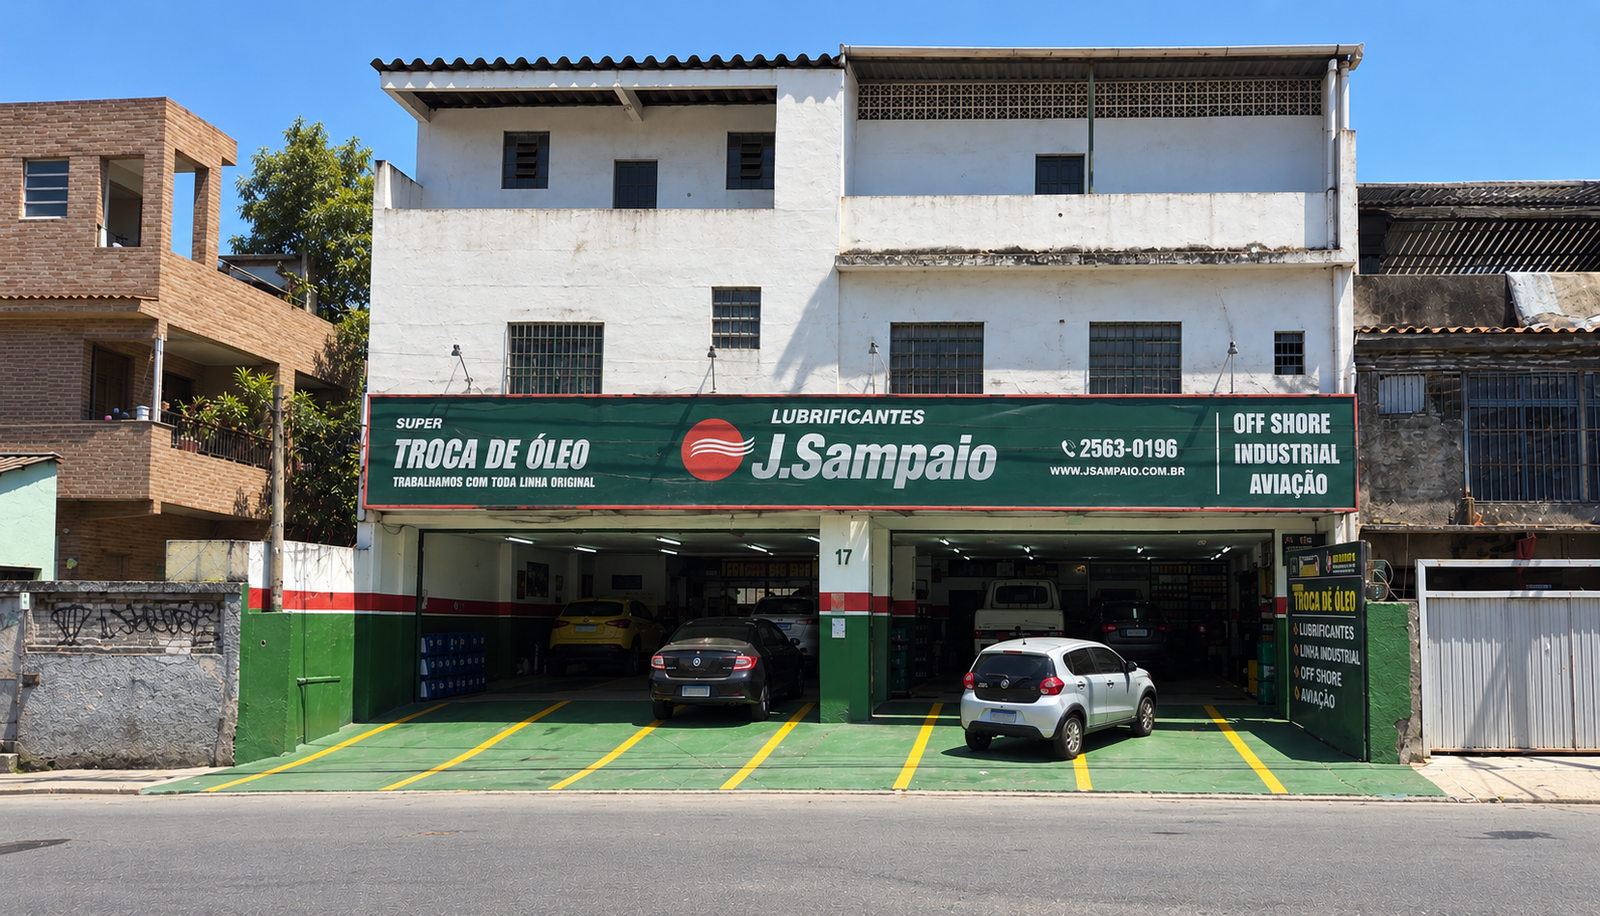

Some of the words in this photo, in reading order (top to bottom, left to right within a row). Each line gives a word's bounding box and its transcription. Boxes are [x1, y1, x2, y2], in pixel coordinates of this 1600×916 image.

[395, 417, 443, 429] SUPER
[770, 408, 926, 425] LUBRIFICANTES
[1233, 412, 1265, 435] OFF
[1270, 412, 1331, 435] SHORE
[393, 438, 478, 470] TROCA
[484, 438, 521, 470] DE
[525, 432, 590, 470] ÓLEO
[1079, 438, 1178, 459] 2563-0196
[1234, 442, 1340, 465] INDUSTRIAL
[751, 432, 998, 489] J.Sampaio
[1050, 466, 1186, 477] WWW.JSAMPAIO.COM.BR
[393, 476, 463, 488] TRABALHAMOS
[466, 476, 488, 488] COM
[491, 476, 516, 488] TODA
[519, 476, 548, 488] LINHA
[551, 476, 595, 488] ORIGINAL
[1249, 469, 1328, 498] AVIAÇÃO
[835, 548, 852, 566] 17
[1293, 590, 1320, 611] TROCA
[1334, 585, 1356, 612] ÓLEO
[1300, 665, 1315, 681] OFF
[1315, 668, 1343, 687] SHORE
